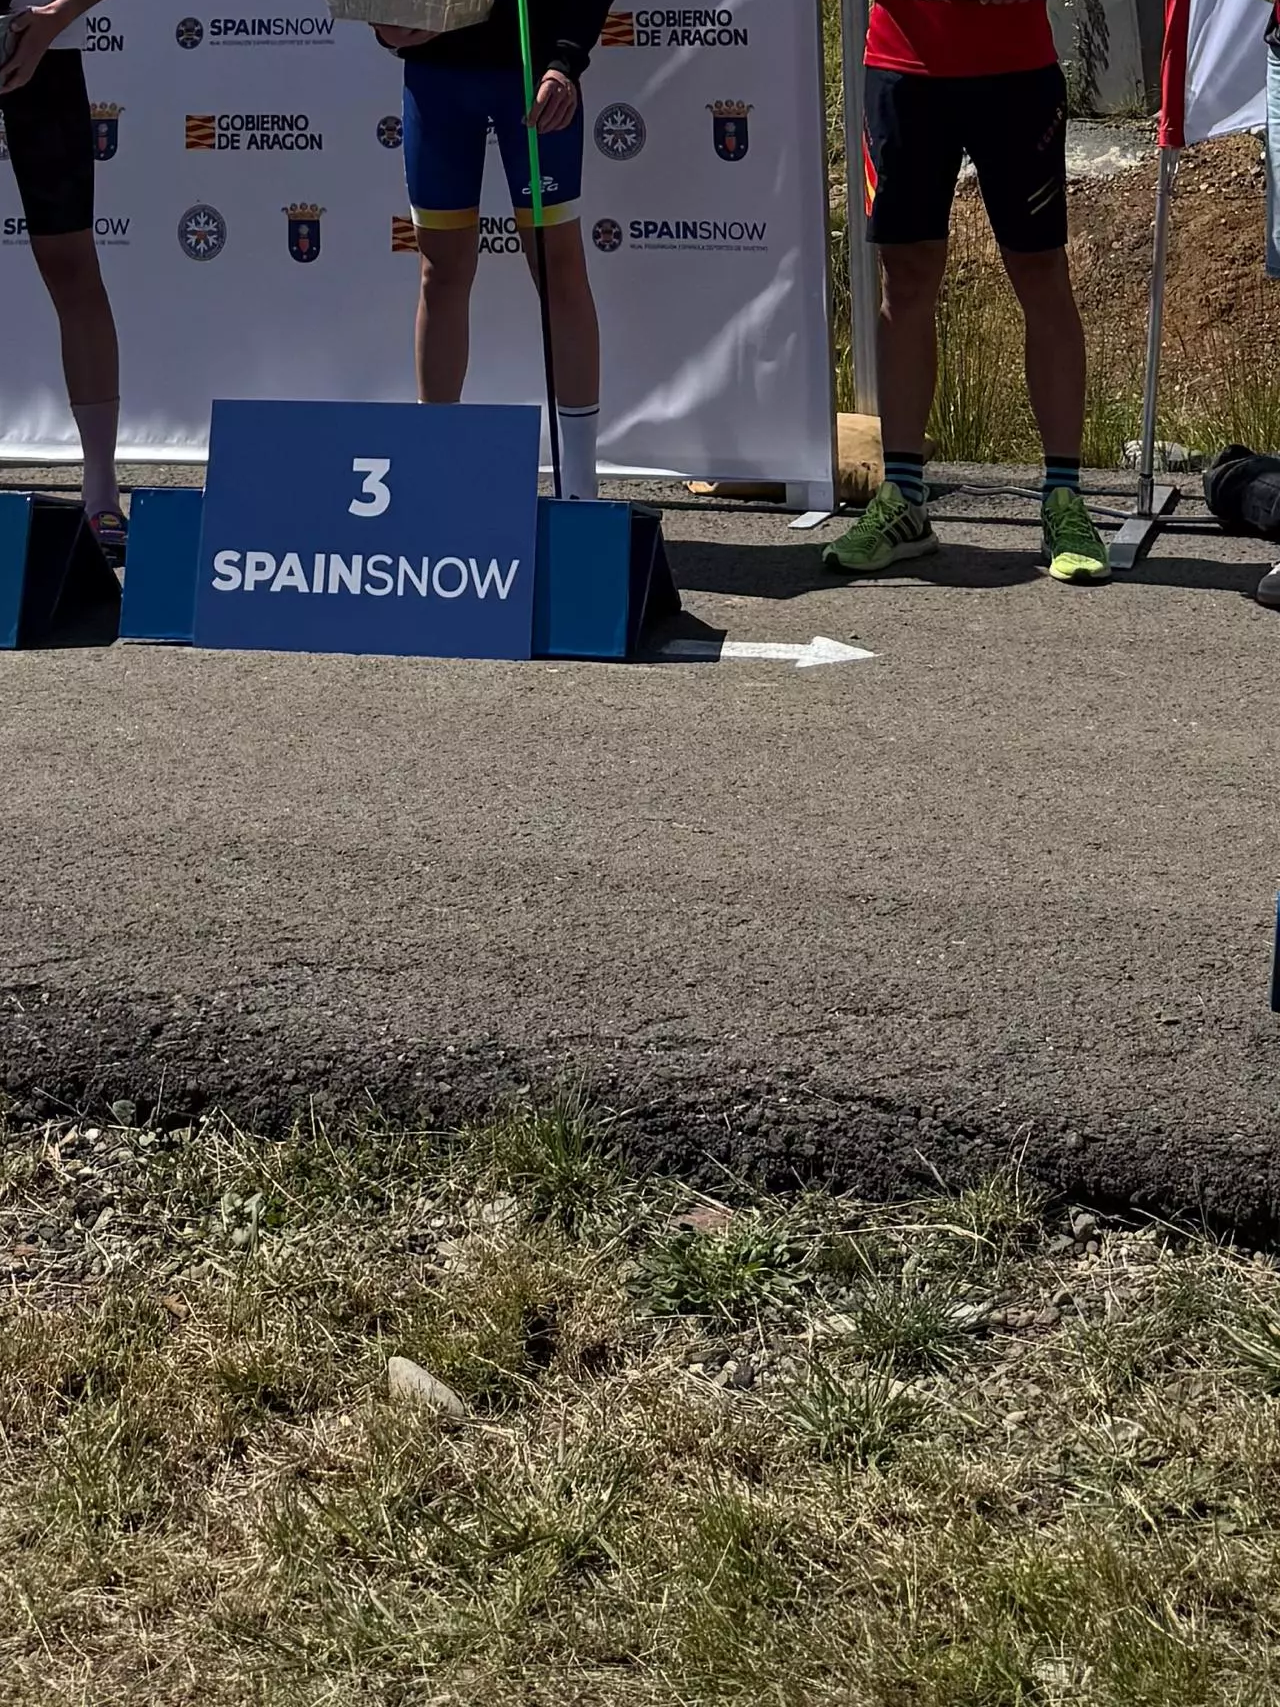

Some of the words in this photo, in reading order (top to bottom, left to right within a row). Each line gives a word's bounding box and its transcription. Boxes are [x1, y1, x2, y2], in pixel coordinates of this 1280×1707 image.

[209, 18, 335, 36] SPAINSNOW
[635, 10, 732, 28] GOBIERNO
[636, 30, 660, 47] DE
[668, 28, 748, 47] ARAGON
[218, 115, 309, 132] GOBIERNO
[217, 134, 241, 150] DE
[246, 134, 323, 150] ARAGON
[629, 220, 767, 241] SPAINSNOW
[348, 458, 391, 517] 3
[211, 550, 520, 600] SPAINSNOW
